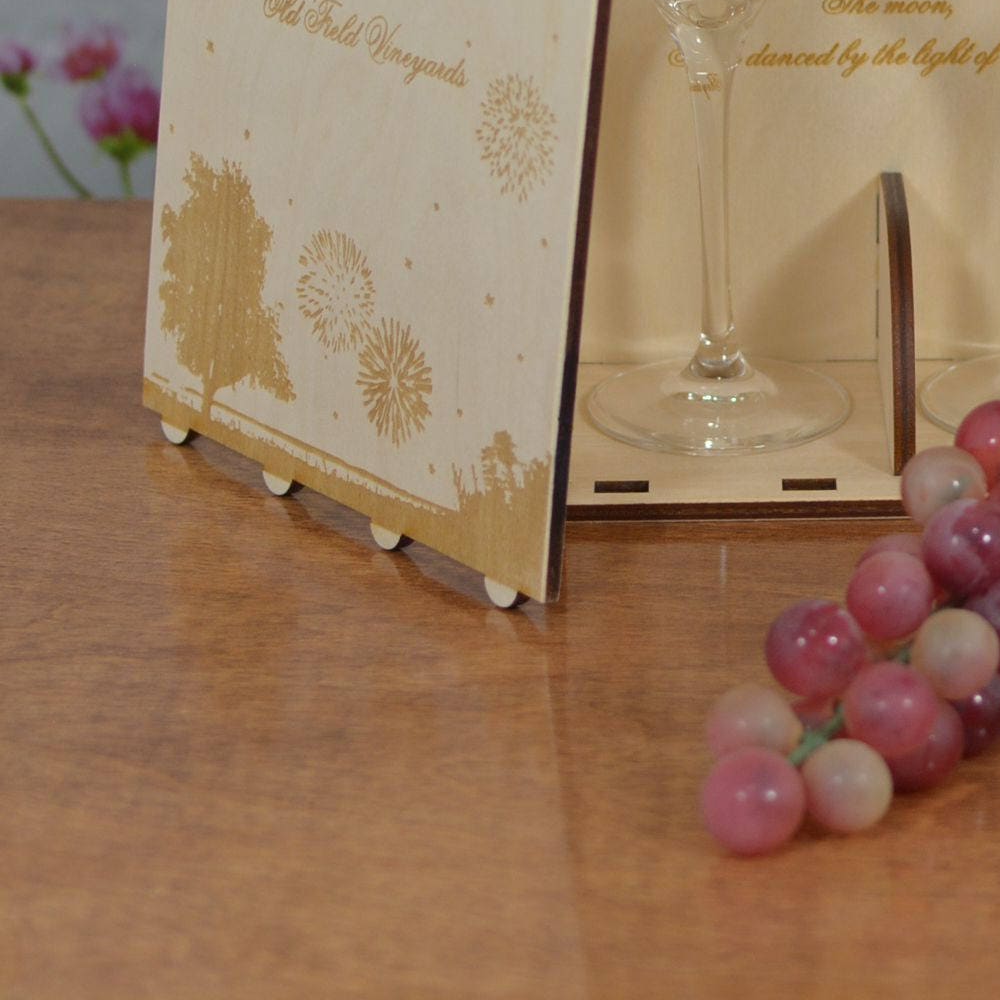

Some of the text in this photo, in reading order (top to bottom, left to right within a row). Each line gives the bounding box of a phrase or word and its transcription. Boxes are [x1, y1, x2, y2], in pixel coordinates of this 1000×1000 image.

[883, 0, 955, 19] moon,
[365, 15, 469, 89] Vineyards
[745, 42, 835, 67] danced
[836, 38, 869, 79] by
[871, 38, 910, 67] the
[911, 37, 976, 78] light
